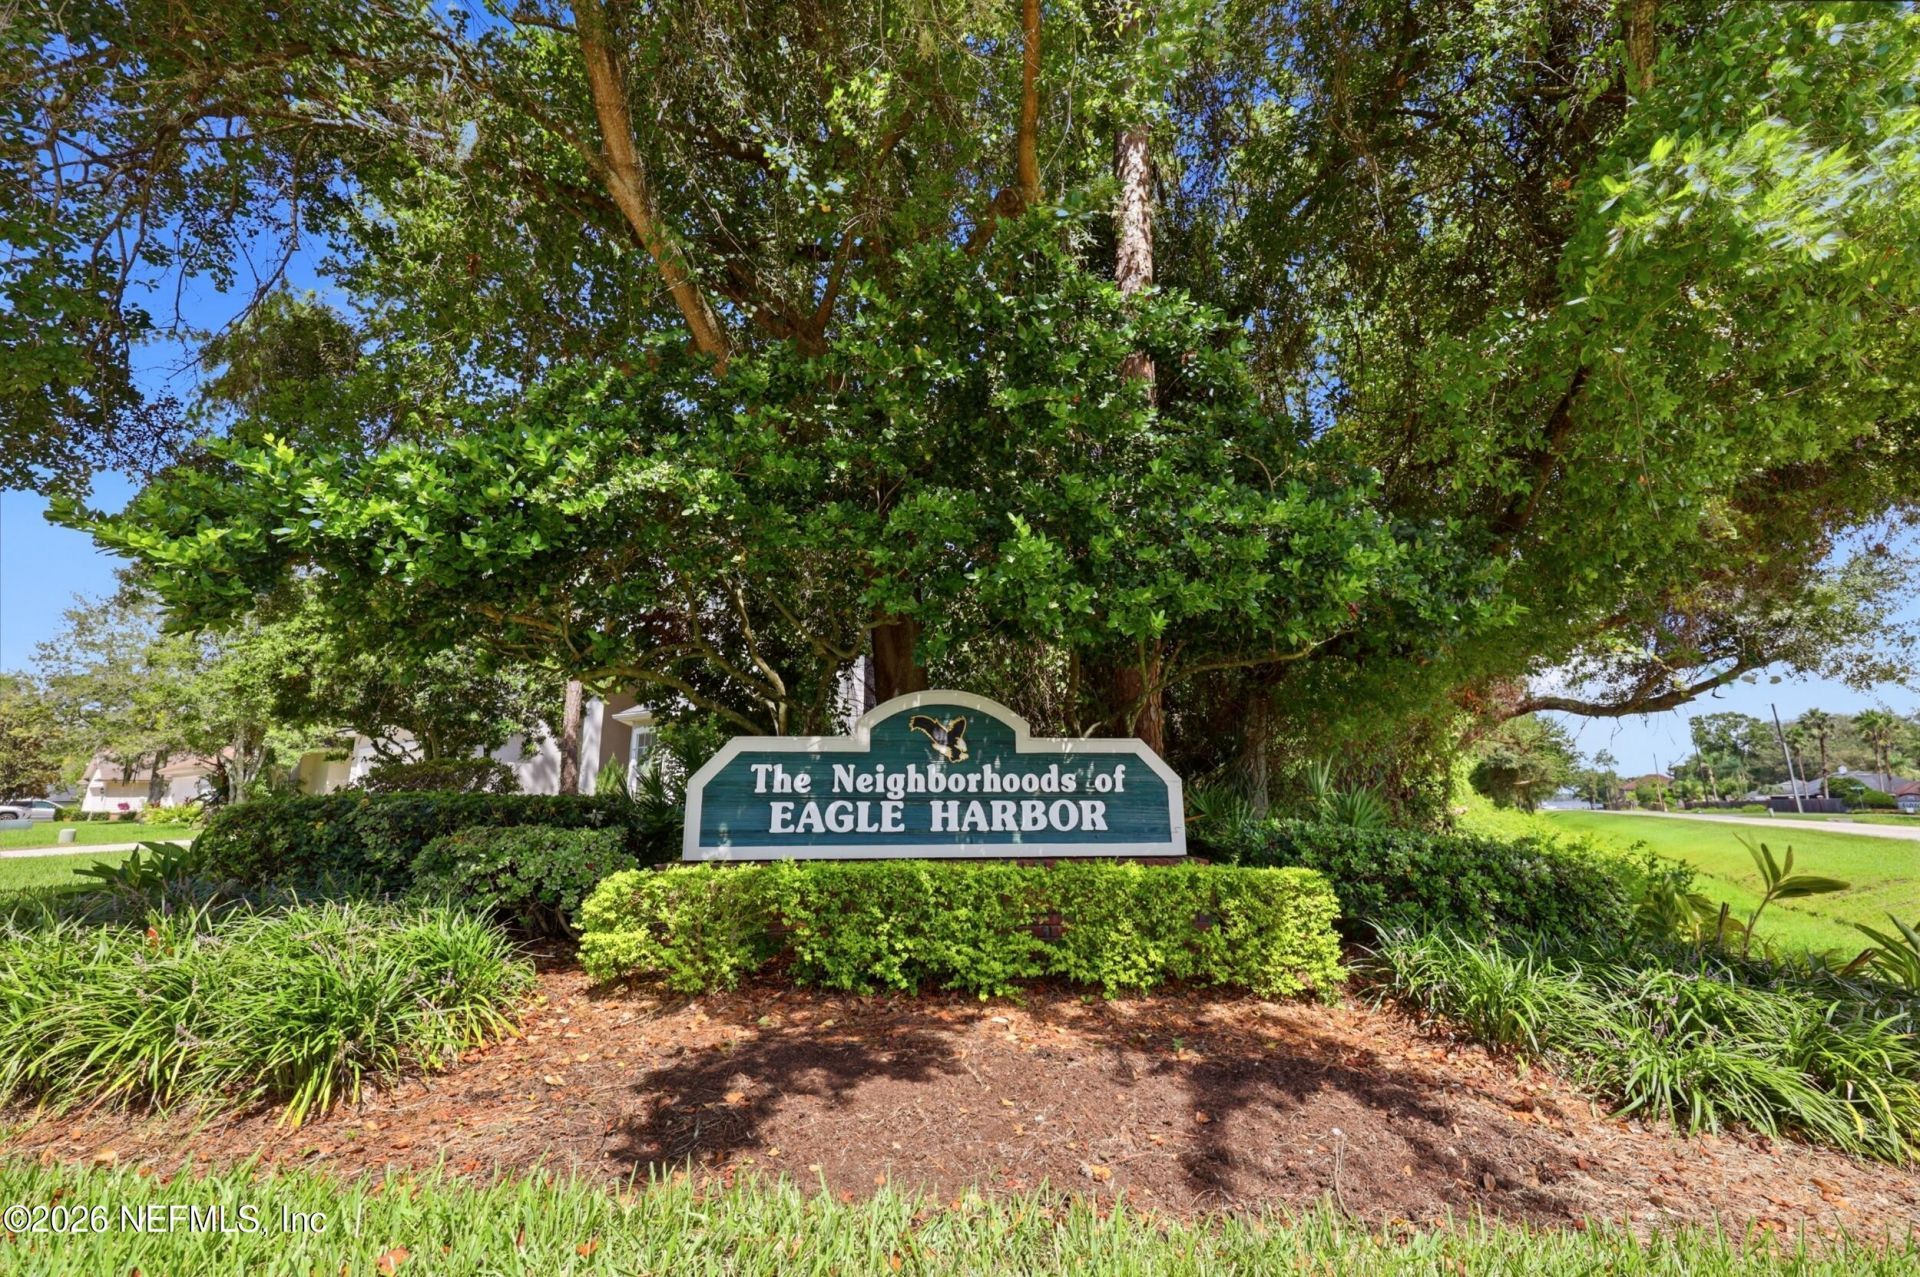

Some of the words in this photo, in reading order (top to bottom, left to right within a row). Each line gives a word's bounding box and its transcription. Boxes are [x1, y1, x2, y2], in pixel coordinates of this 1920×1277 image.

[750, 763, 812, 793] The
[832, 763, 1077, 800] Neighborhoods
[1094, 763, 1126, 793] of
[769, 800, 905, 834] EAGLE
[930, 799, 1108, 833] HARBOR
